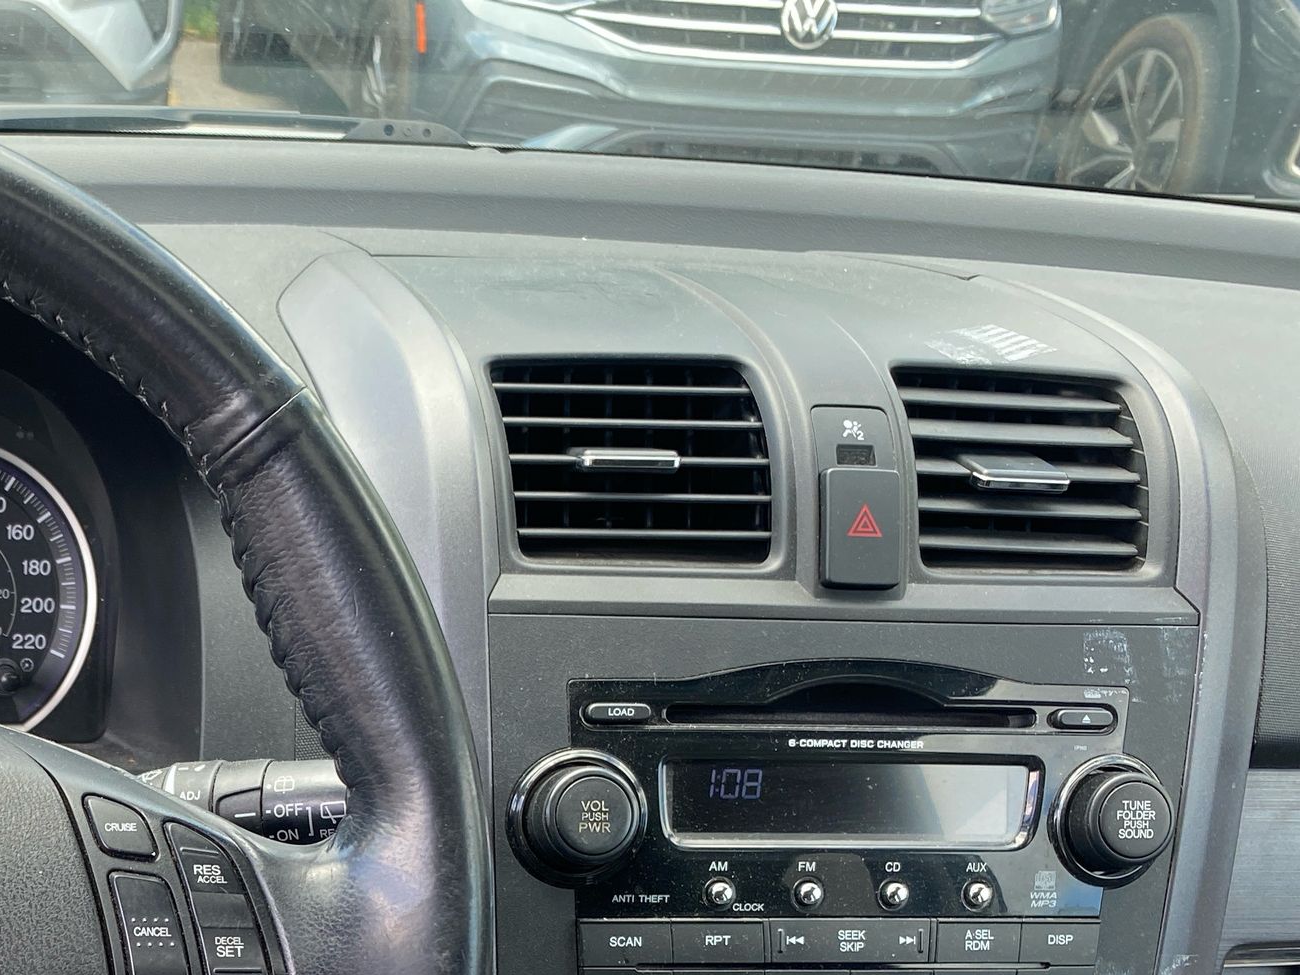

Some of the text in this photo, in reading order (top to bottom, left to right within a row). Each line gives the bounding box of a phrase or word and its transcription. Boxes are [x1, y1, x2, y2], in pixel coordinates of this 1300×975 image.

[6, 524, 34, 541] 160
[22, 559, 51, 576] 180
[20, 597, 55, 614] 200
[12, 633, 47, 650] 220
[608, 707, 635, 717] LOAD
[788, 739, 924, 749] 6-COMPACT DISC CHANGER
[709, 768, 763, 800] 1:08
[180, 790, 201, 800] ADJ
[273, 803, 304, 818] OFF
[581, 800, 609, 812] VOL
[1122, 801, 1151, 811] TUNE
[581, 812, 609, 821] PUSH
[1116, 810, 1156, 821] FOLDER
[104, 822, 137, 832] CRUISE
[578, 822, 611, 833] PWR
[1124, 820, 1149, 830] PUSH
[276, 828, 299, 841] ON
[1118, 829, 1154, 840] SOUND
[193, 864, 221, 876] RES
[708, 862, 728, 872] AM
[798, 862, 816, 872] FM
[885, 862, 901, 872] CD
[966, 862, 987, 873] AUX
[197, 875, 227, 884] ACCEL
[612, 895, 670, 904] ANTI THEFT
[1030, 892, 1057, 900] WMA
[732, 903, 764, 912] CLOCK
[1030, 900, 1057, 908] MP3
[133, 926, 172, 937] CANCEL
[838, 930, 866, 941] SEEK
[215, 936, 244, 946] DECEL
[609, 936, 642, 947] SCAN
[705, 935, 731, 946] RPT
[1048, 934, 1073, 945] DISP
[839, 941, 865, 952] SKIP
[965, 940, 990, 951] RDM
[216, 946, 244, 957] SET
